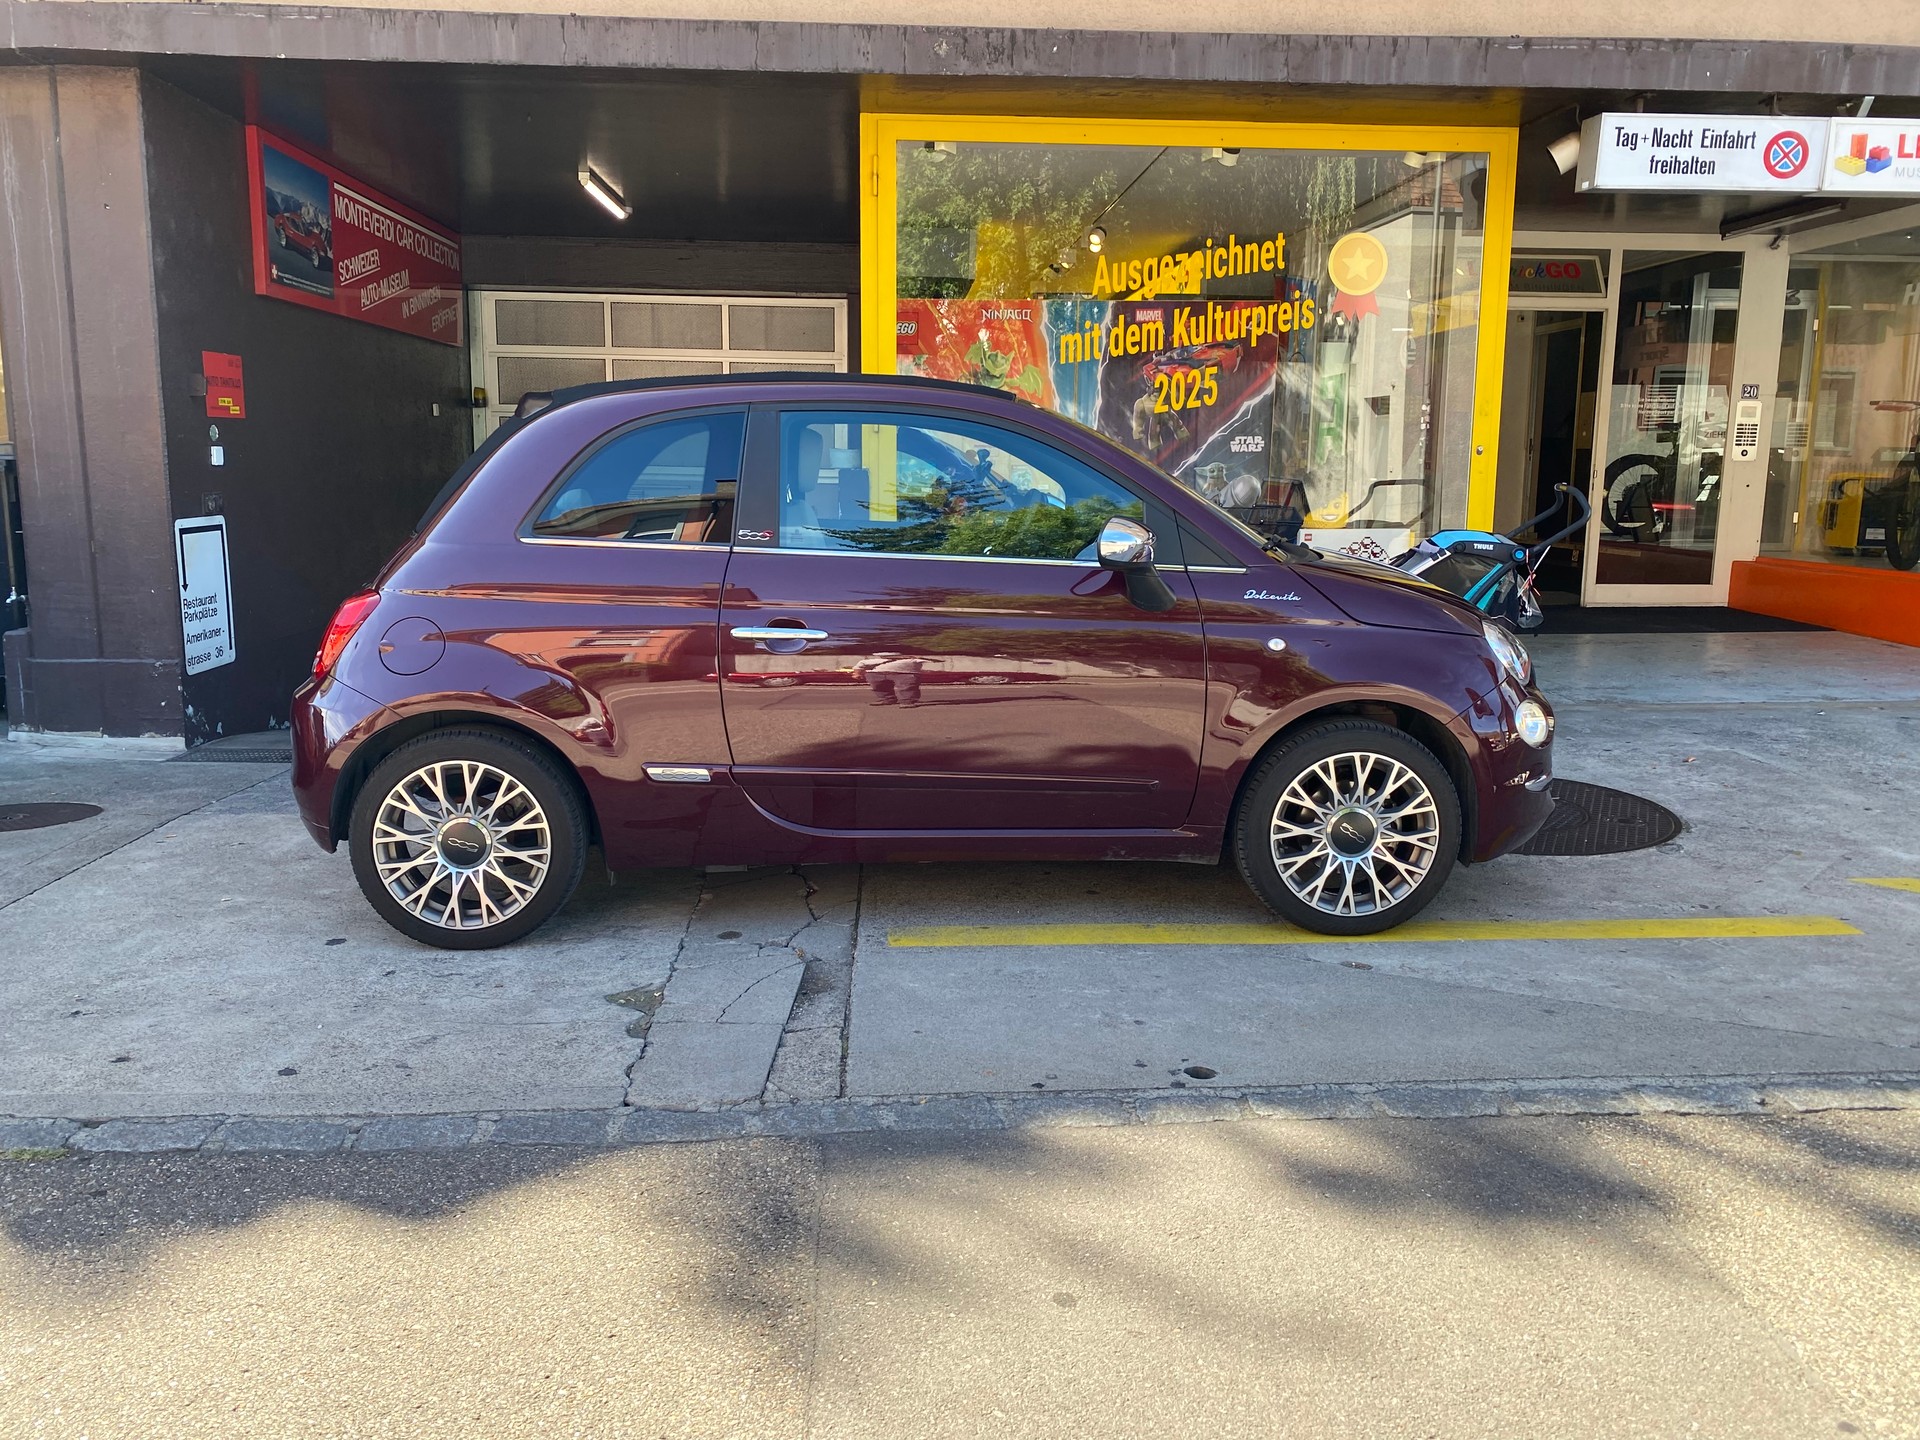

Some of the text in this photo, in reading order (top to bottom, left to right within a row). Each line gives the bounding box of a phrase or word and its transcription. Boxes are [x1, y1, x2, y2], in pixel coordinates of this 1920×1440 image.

[1700, 128, 1757, 149] Einfahrt
[1897, 133, 1920, 158] L
[1649, 155, 1716, 175] freihalten
[334, 193, 460, 271] MONTEVERDI CAR COLLECTION
[338, 248, 381, 282] SCHWEIZER
[1092, 232, 1286, 299] Ausgezeichnet
[402, 285, 441, 319] IN BINNINGEN
[981, 309, 1033, 323] NINJAGO
[1136, 310, 1163, 321] MARVEL
[897, 321, 917, 334] EGO
[1059, 290, 1315, 365] mit dem Kulturpreis
[1154, 366, 1219, 414] 2025
[1744, 386, 1757, 397] 20
[1230, 436, 1265, 444] STAR
[1230, 443, 1265, 452] WARS
[1473, 543, 1494, 551] THULE
[182, 592, 218, 611] Restaurant
[1243, 589, 1302, 601] Dolcevita
[184, 606, 218, 623] Parkplätze
[186, 627, 225, 645] Amerikaner-
[187, 645, 224, 667] strasse 36
